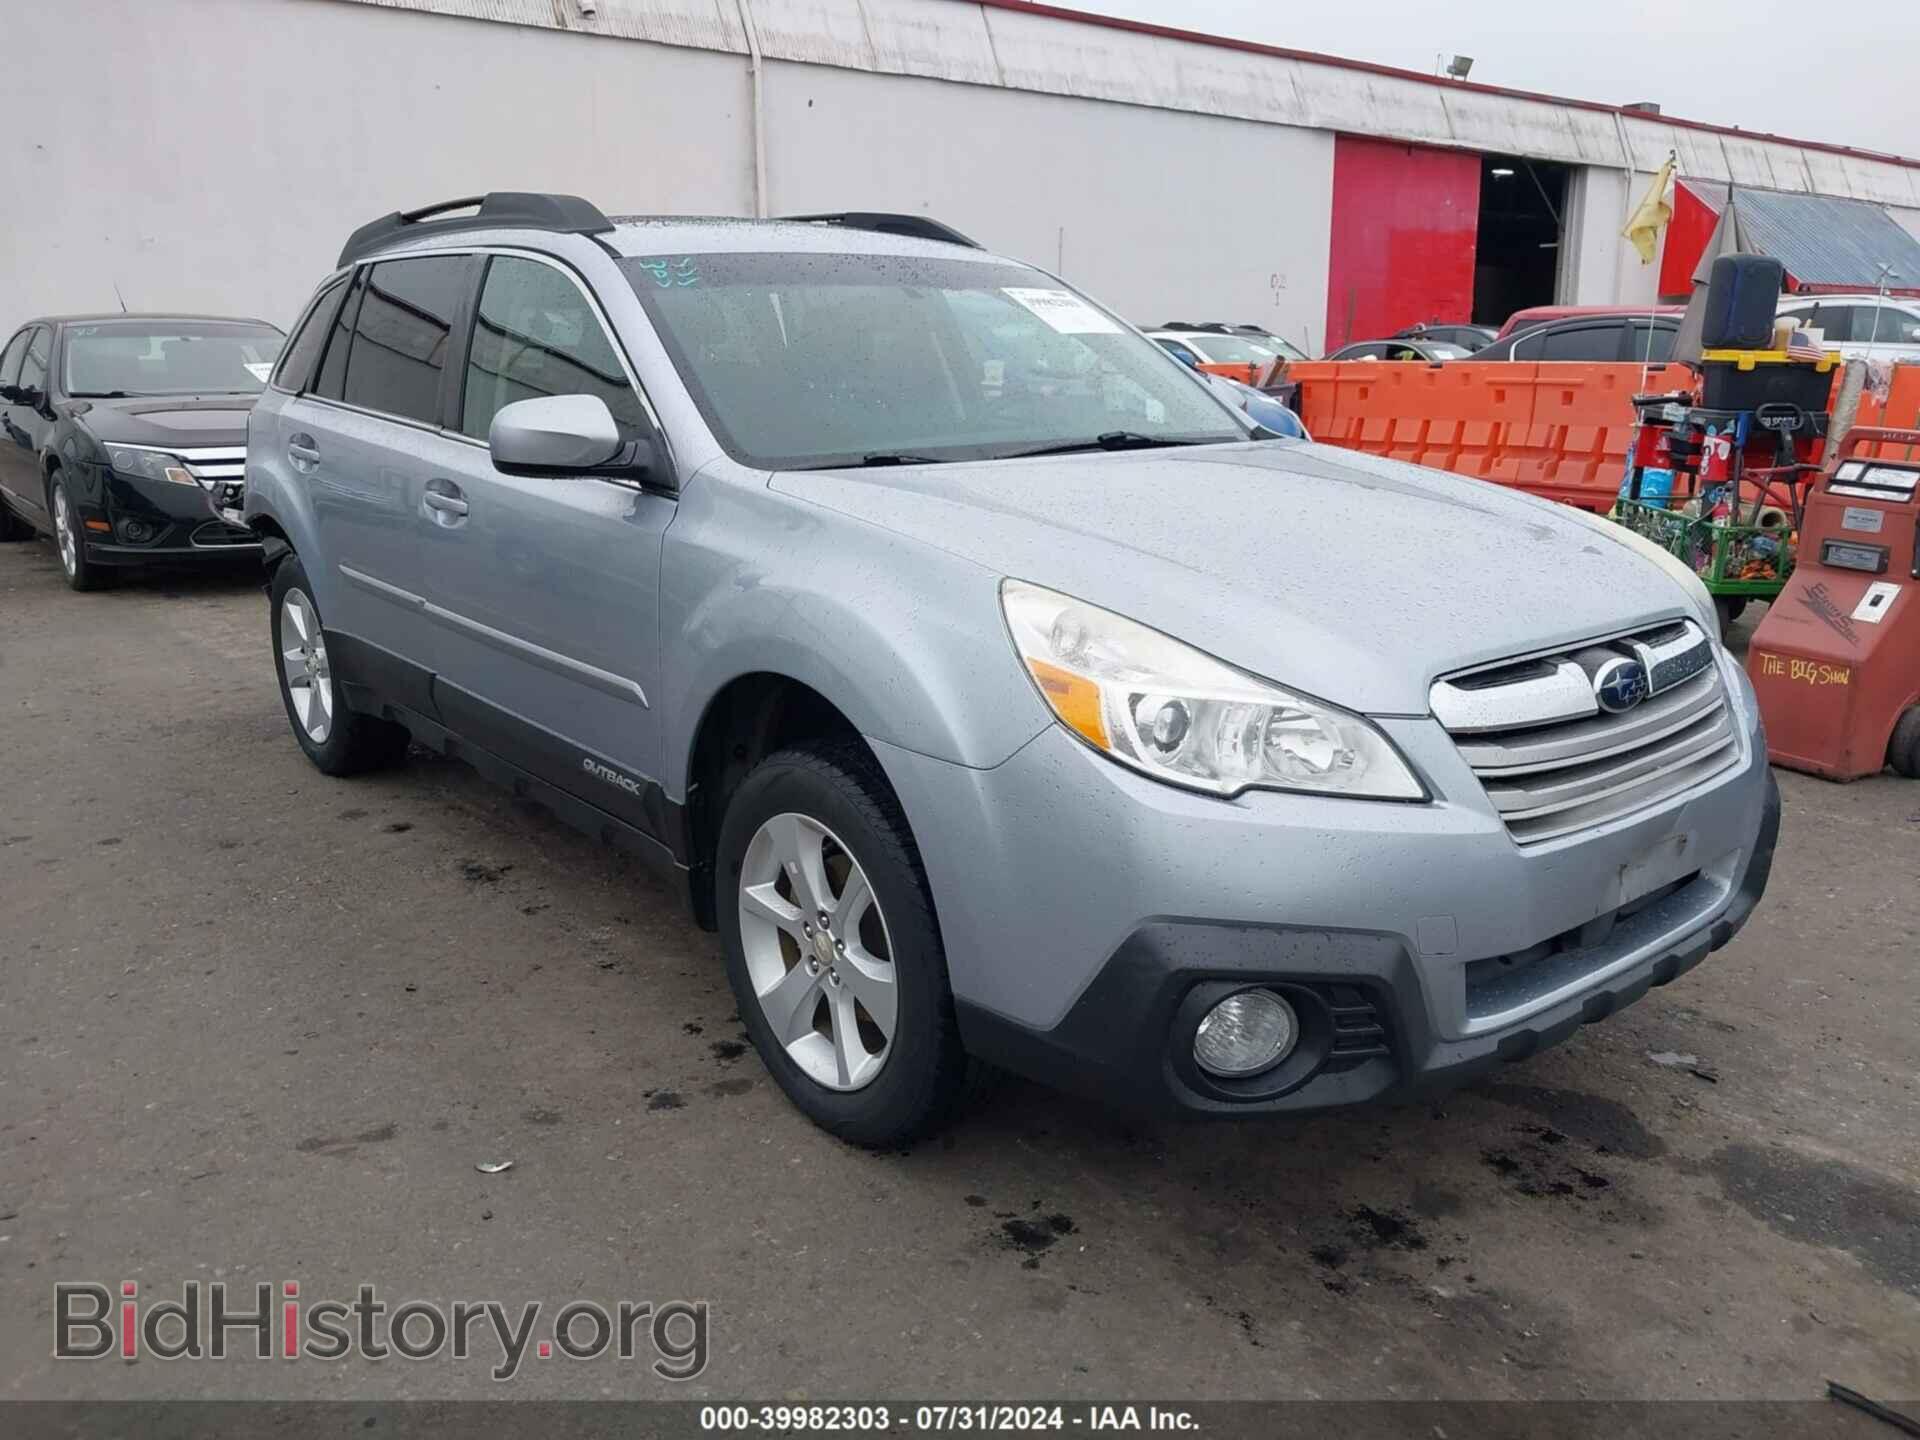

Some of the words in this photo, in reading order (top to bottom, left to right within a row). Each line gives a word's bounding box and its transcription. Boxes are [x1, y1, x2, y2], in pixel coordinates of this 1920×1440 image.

[1760, 652, 1785, 675] THE
[1791, 659, 1818, 685] BIG
[583, 758, 641, 796] OUTBACK
